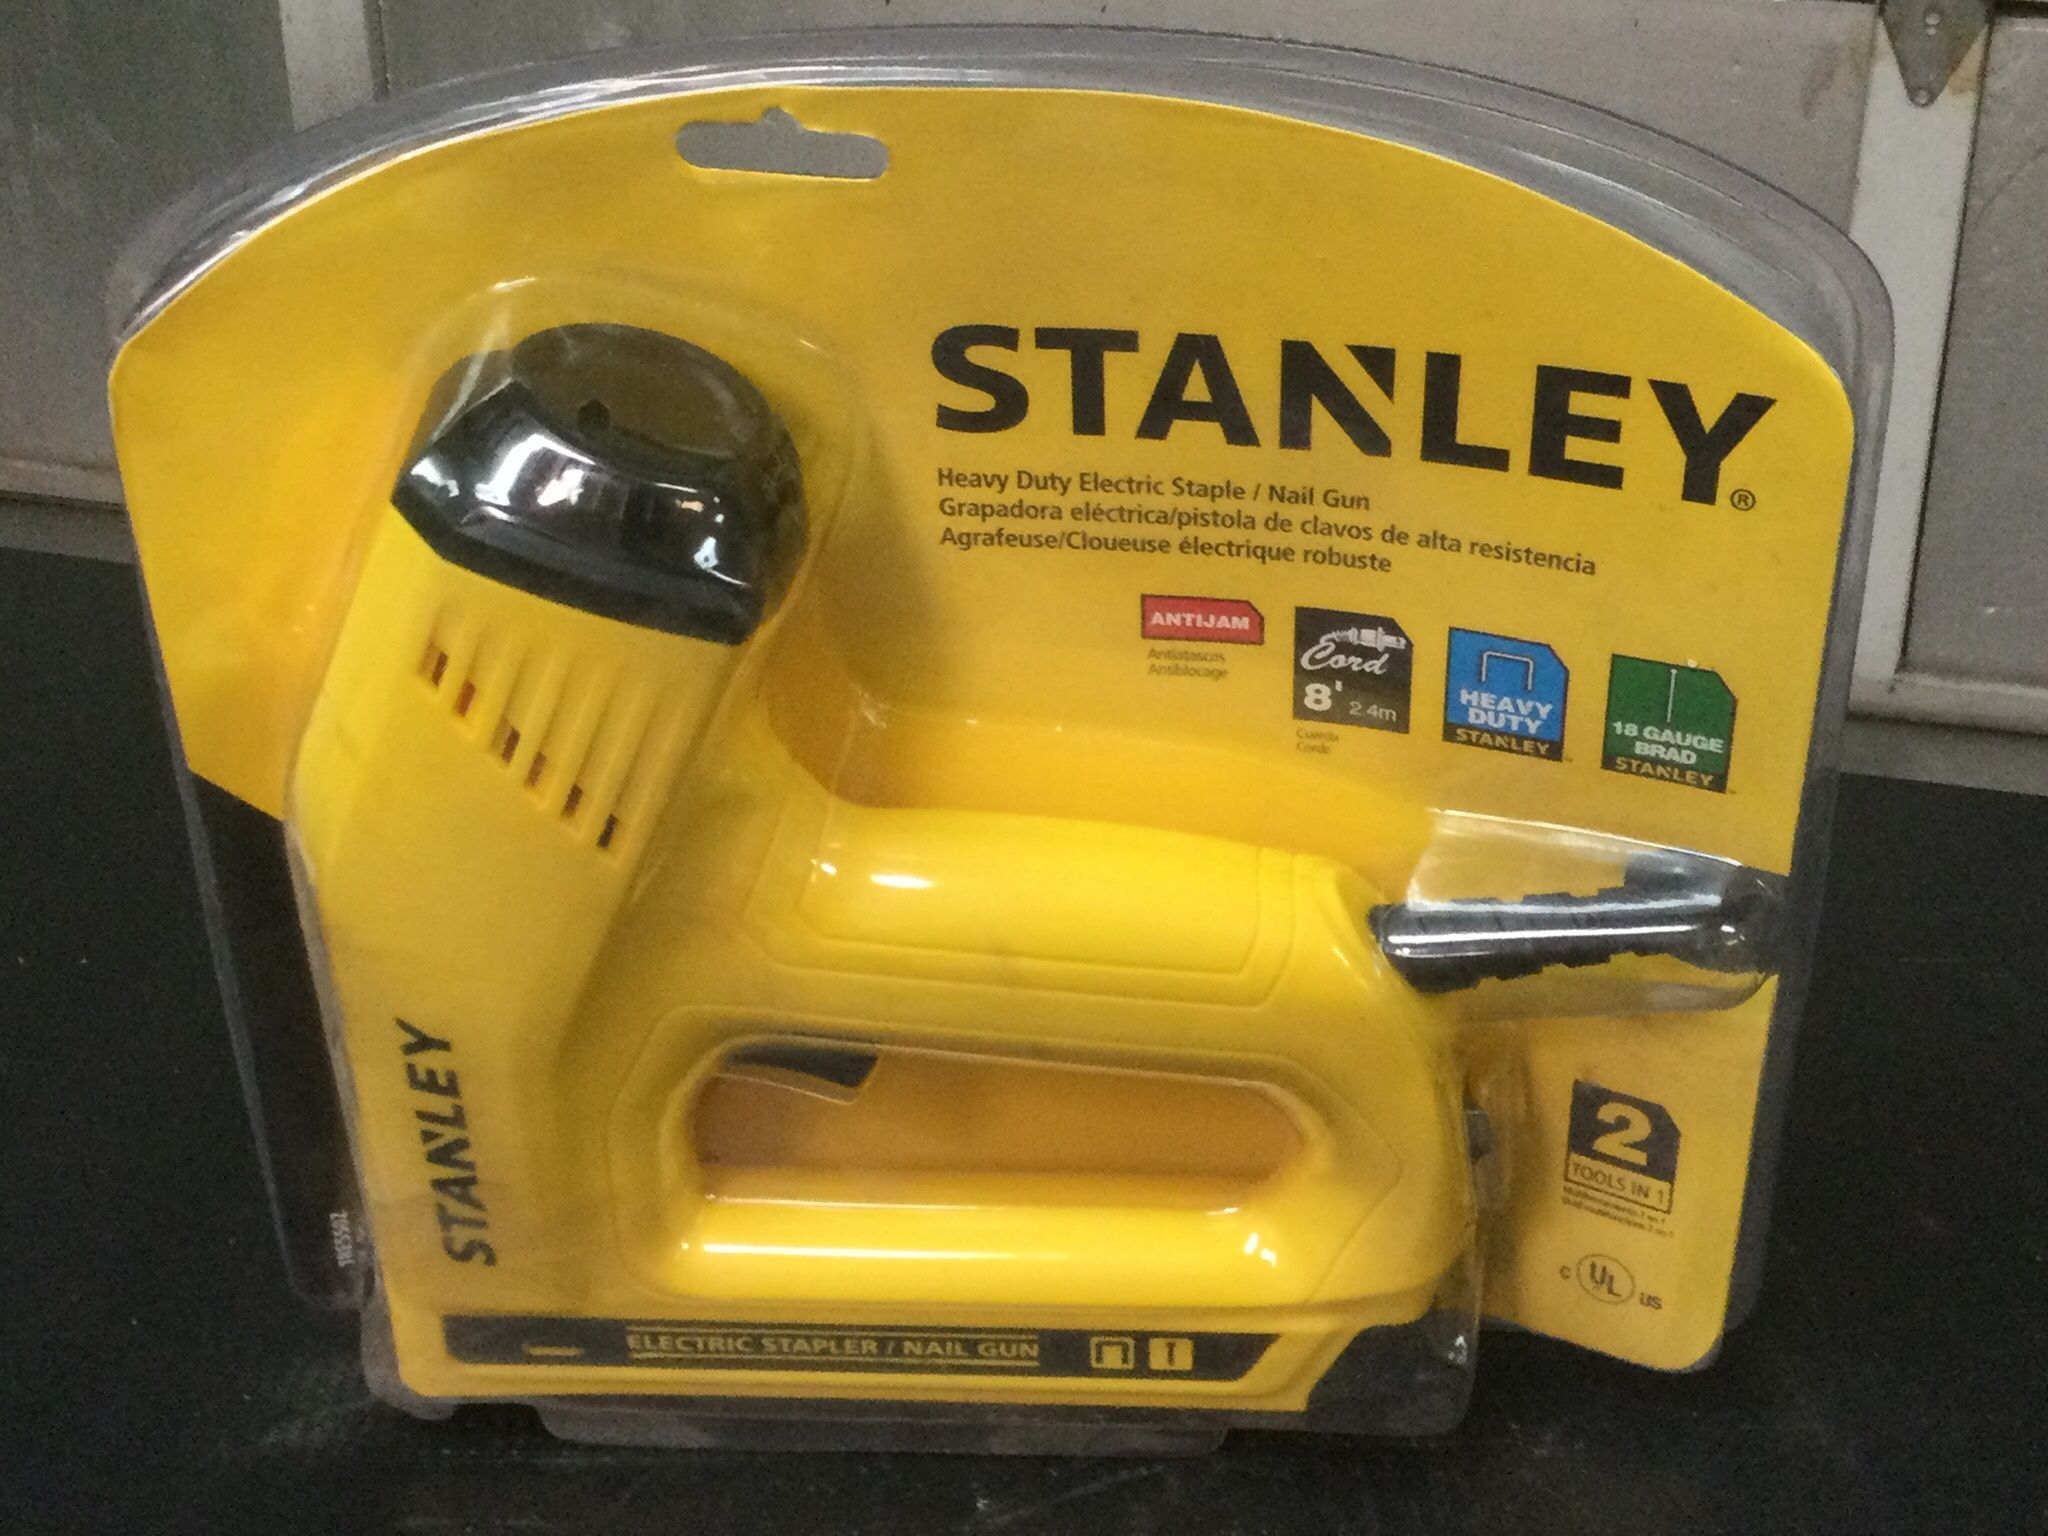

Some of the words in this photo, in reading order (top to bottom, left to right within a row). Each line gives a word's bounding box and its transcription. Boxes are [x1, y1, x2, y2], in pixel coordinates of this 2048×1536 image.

[937, 468, 1008, 493] Heavy
[1017, 470, 1071, 495] Duty
[1080, 472, 1164, 495] Electric
[1172, 477, 1246, 503] Staple
[1268, 484, 1314, 507] Nail
[1323, 489, 1370, 511] Gun
[939, 497, 1063, 523] Grapadora
[1071, 501, 1256, 530] eléctrica/pistola
[1264, 511, 1292, 532] de
[1301, 515, 1373, 541] clavos
[1381, 523, 1409, 546] de
[1417, 530, 1462, 554] alta
[1470, 540, 1596, 575] resistencia
[940, 527, 1171, 554] Agrafeuse/Cloueuse
[1178, 537, 1296, 564] électrique
[1303, 547, 1392, 573] robuste
[1150, 612, 1250, 630] ANTIJAM
[1300, 641, 1390, 675] Cord
[1459, 688, 1553, 720] HEAVY
[1468, 707, 1544, 735] DUTY
[1612, 721, 1638, 737] 18
[1643, 726, 1724, 754] GAUGE
[1456, 728, 1550, 756] STANLEY
[1634, 740, 1697, 765] BRAD
[1615, 756, 1715, 787] STANLEY
[395, 1017, 497, 1267] STANLEY
[1593, 1102, 1651, 1166] 2
[1572, 1161, 1627, 1192] TOOLS
[1631, 1180, 1649, 1200] IN
[1589, 1261, 1622, 1297] UL
[627, 1334, 754, 1352] ELECTRIC
[761, 1336, 879, 1356] STAPLER
[902, 1339, 969, 1357] NAIL
[978, 1340, 1038, 1359] GUN
